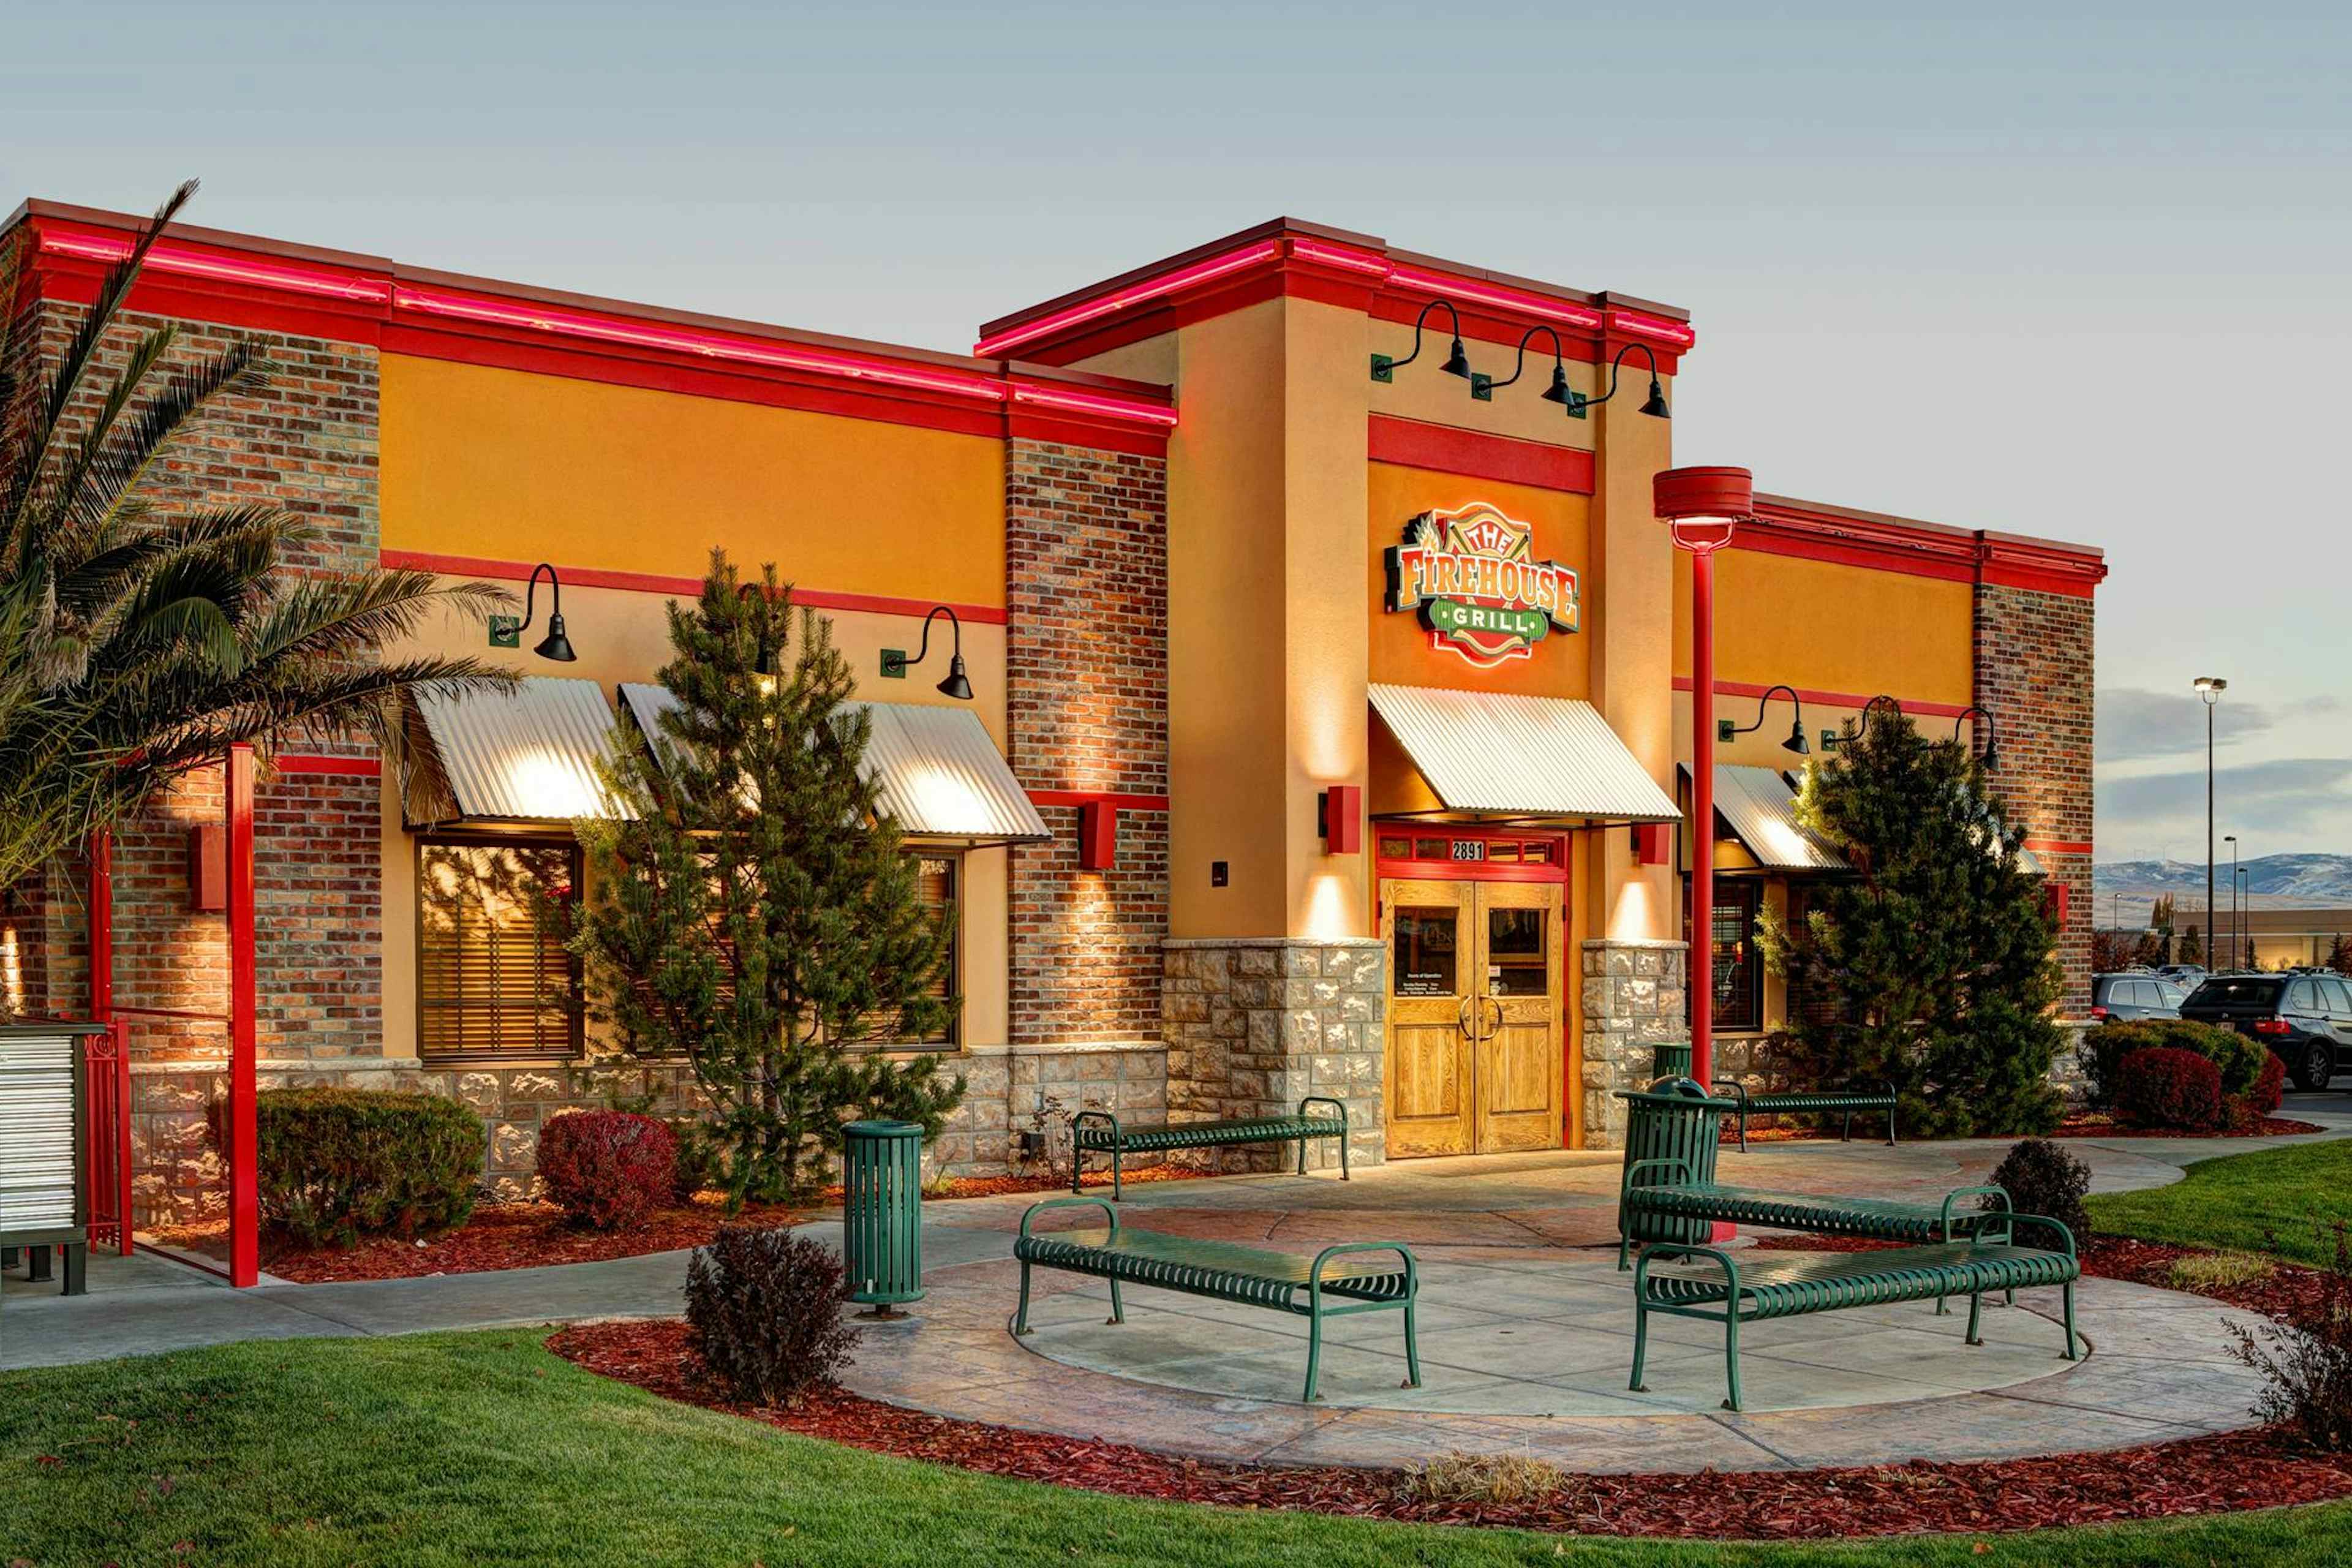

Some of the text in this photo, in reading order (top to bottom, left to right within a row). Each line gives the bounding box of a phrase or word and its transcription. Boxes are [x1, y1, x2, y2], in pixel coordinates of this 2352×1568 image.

[1468, 525, 1513, 553] THE
[1400, 547, 1578, 628] FIREHOUSE
[1453, 608, 1528, 632] GRILL
[1453, 843, 1482, 859] 2891
